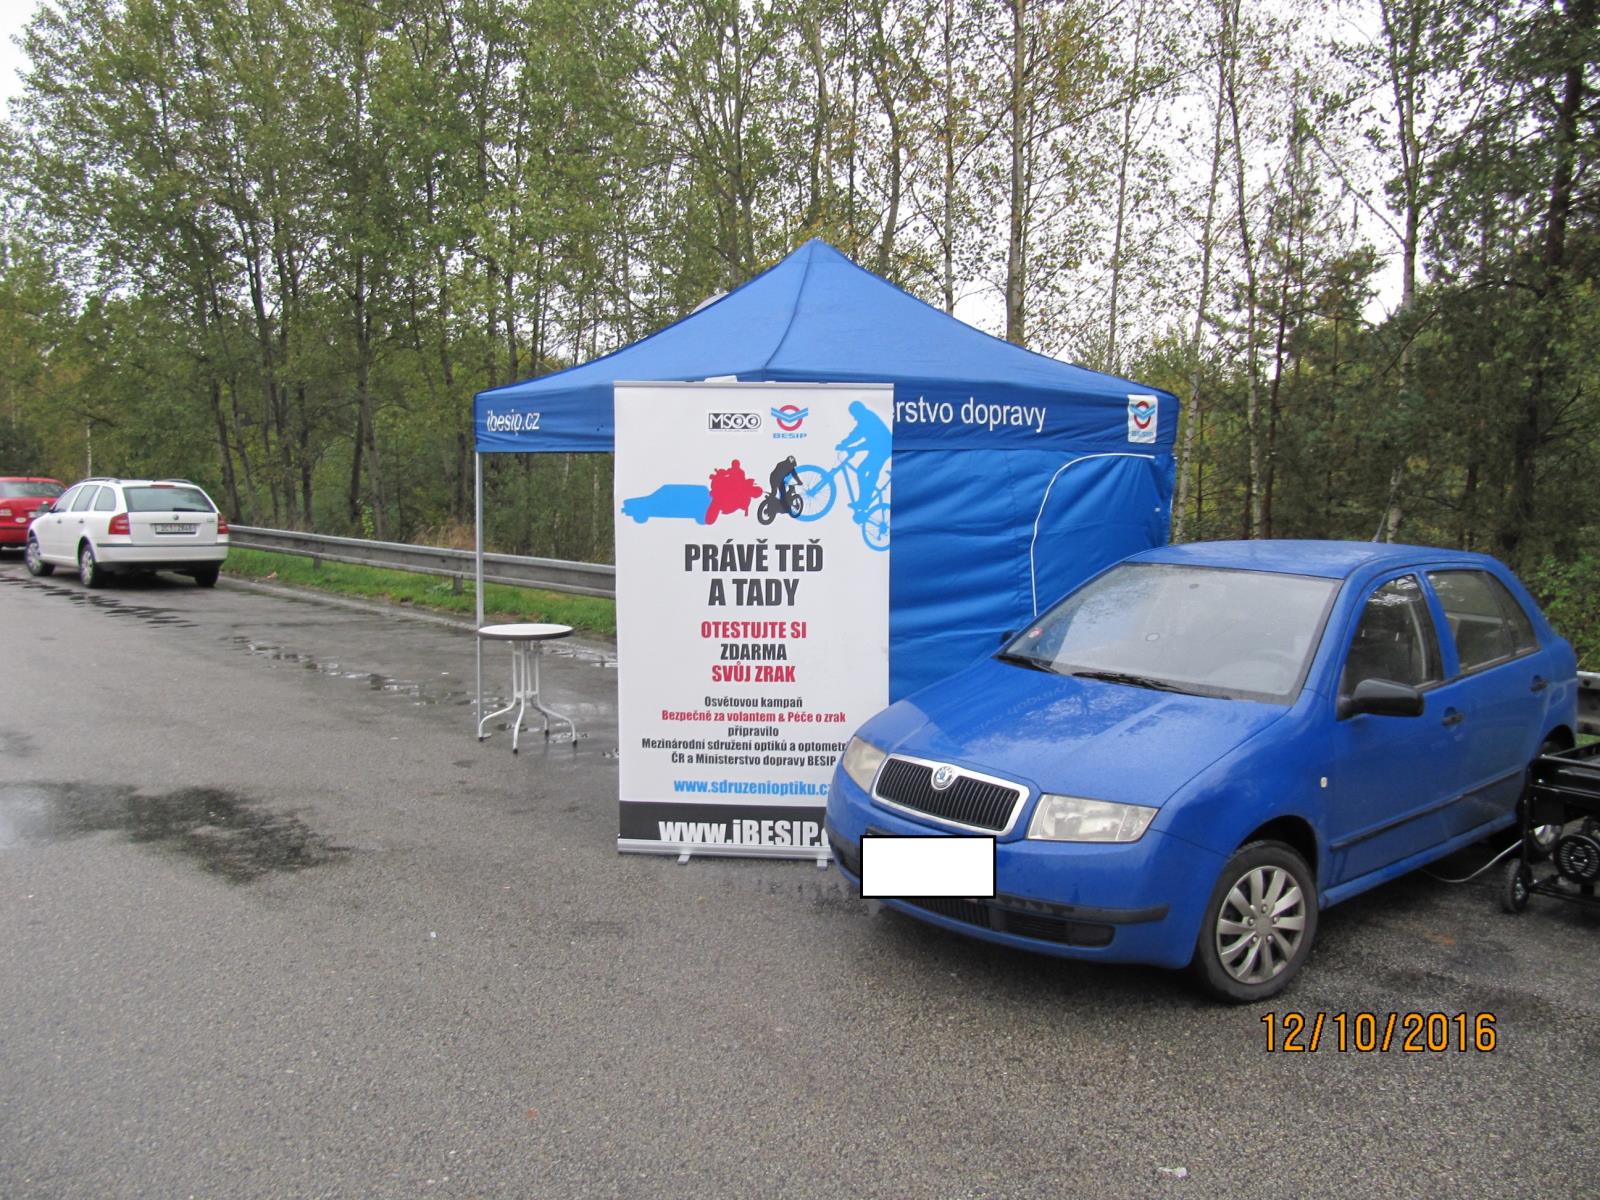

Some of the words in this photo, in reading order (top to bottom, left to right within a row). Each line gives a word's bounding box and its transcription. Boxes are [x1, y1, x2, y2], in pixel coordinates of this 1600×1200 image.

[486, 408, 541, 437] ibesip.cz
[891, 395, 954, 424] rstvo
[961, 397, 1047, 433] dopravy
[684, 538, 769, 572] PRÁVĚ
[774, 539, 824, 572] TEĎ
[708, 578, 727, 607] A
[732, 578, 800, 607] TADY
[701, 620, 787, 639] OTESTUJTE
[790, 621, 807, 639] SI
[720, 643, 787, 661] ZDARMA
[711, 661, 751, 683] SVŮJ
[755, 665, 796, 683] ZRAK
[704, 696, 759, 708] Osvětovou
[760, 696, 803, 709] kampaň
[661, 709, 712, 722] Bezpečně
[713, 712, 725, 721] za
[727, 711, 776, 723] volantem
[778, 714, 786, 723] &
[787, 711, 814, 723] Péče
[815, 713, 822, 722] o
[823, 711, 846, 723] zrak
[727, 724, 780, 738] připravilo
[641, 737, 706, 750] Mezinárodní
[707, 739, 753, 751] sdružení
[754, 739, 788, 752] optiků
[789, 743, 796, 752] a
[798, 741, 849, 753] optometr
[671, 750, 685, 764] ČR
[687, 754, 694, 764] a
[695, 752, 761, 766] Ministerstvo
[762, 754, 806, 768] dopravy
[807, 755, 837, 767] BESIP
